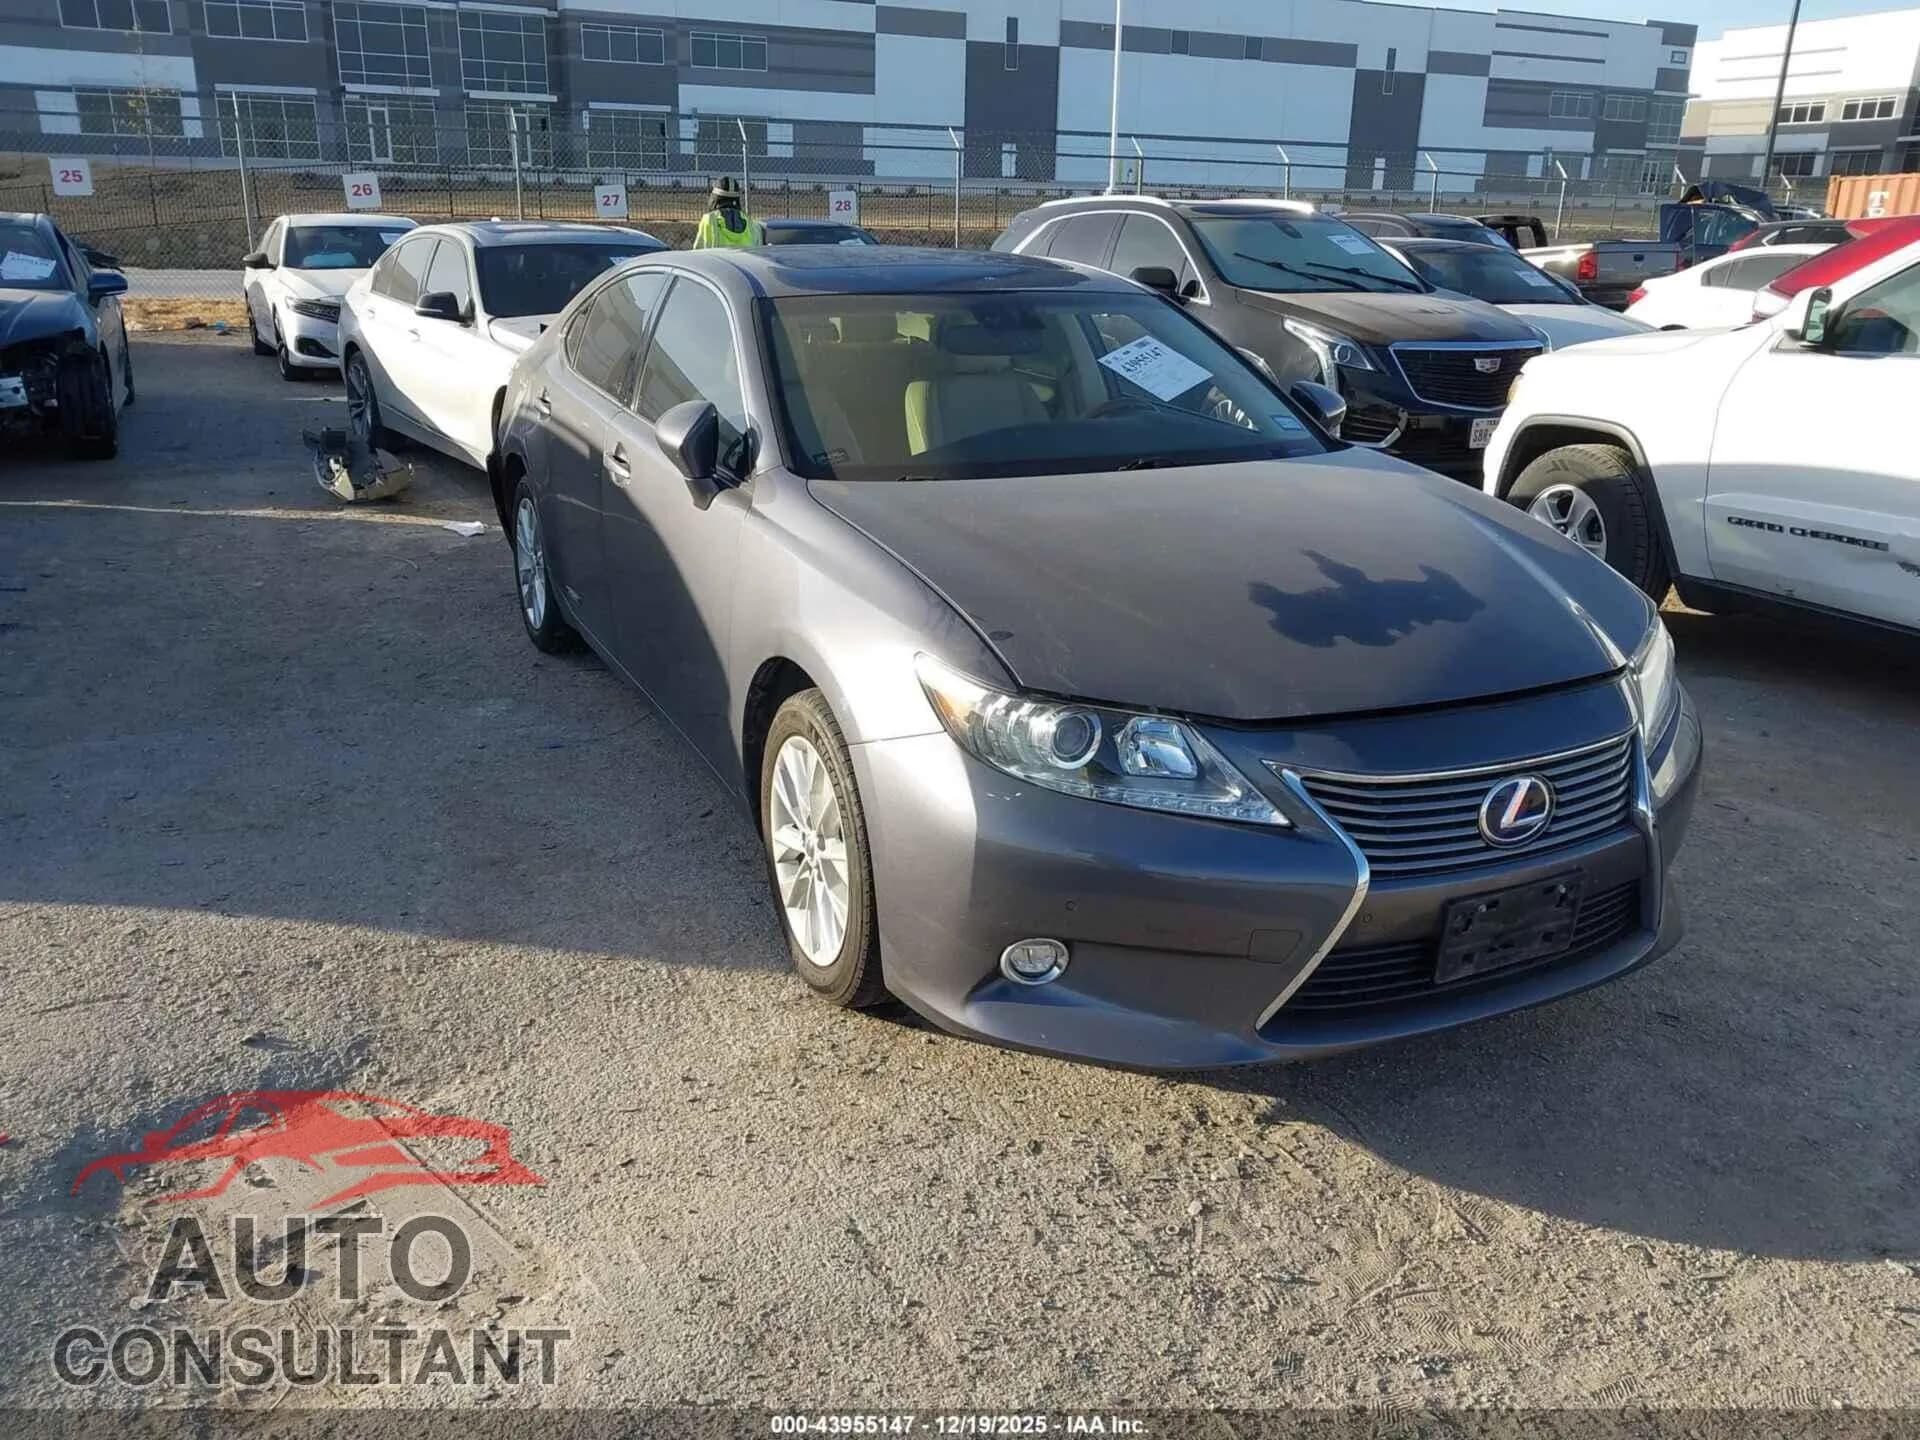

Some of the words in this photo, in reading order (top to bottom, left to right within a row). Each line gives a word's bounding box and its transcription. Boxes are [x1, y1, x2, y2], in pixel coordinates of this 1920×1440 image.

[60, 169, 83, 183] 25
[351, 183, 373, 197] 26
[602, 194, 620, 207] 27
[835, 200, 852, 211] 28
[1727, 515, 1784, 534] GRAND
[1789, 526, 1889, 552] CHEROKEE
